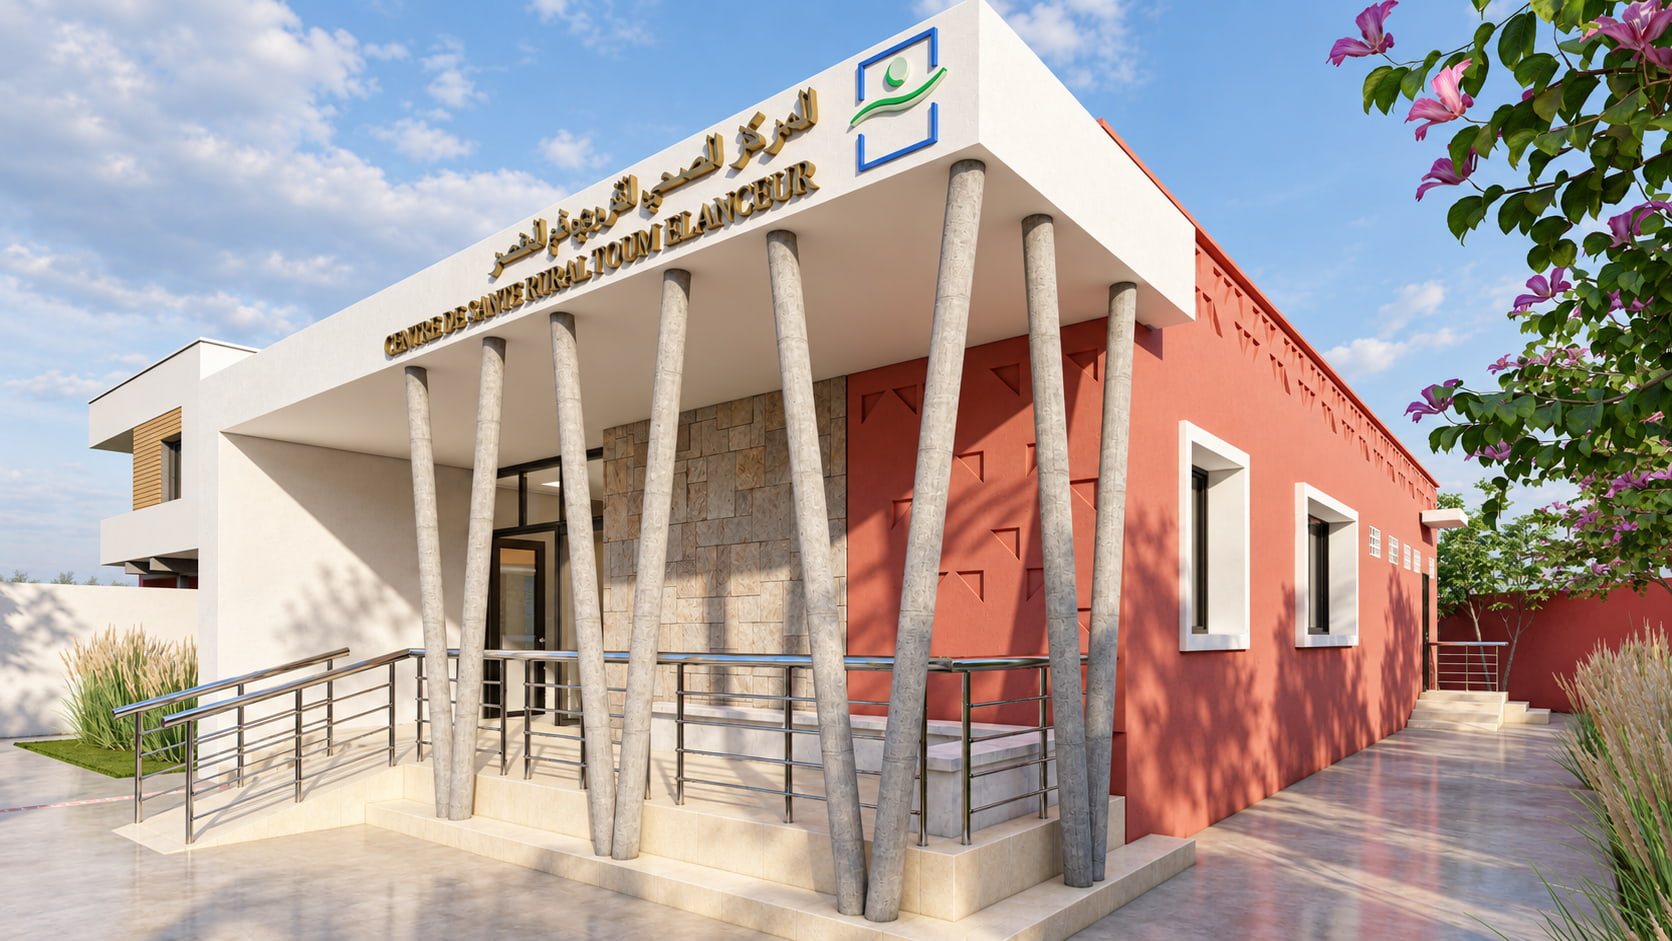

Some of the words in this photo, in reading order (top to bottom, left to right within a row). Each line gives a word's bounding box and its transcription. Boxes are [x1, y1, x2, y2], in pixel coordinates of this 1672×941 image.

[730, 87, 818, 170] المركز
[642, 132, 724, 214] الصحي
[384, 316, 443, 356] CENTRE
[443, 306, 468, 334] DE
[467, 281, 525, 323] SANTE
[525, 255, 593, 301] RURAL
[664, 160, 820, 246] ELANCEUR
